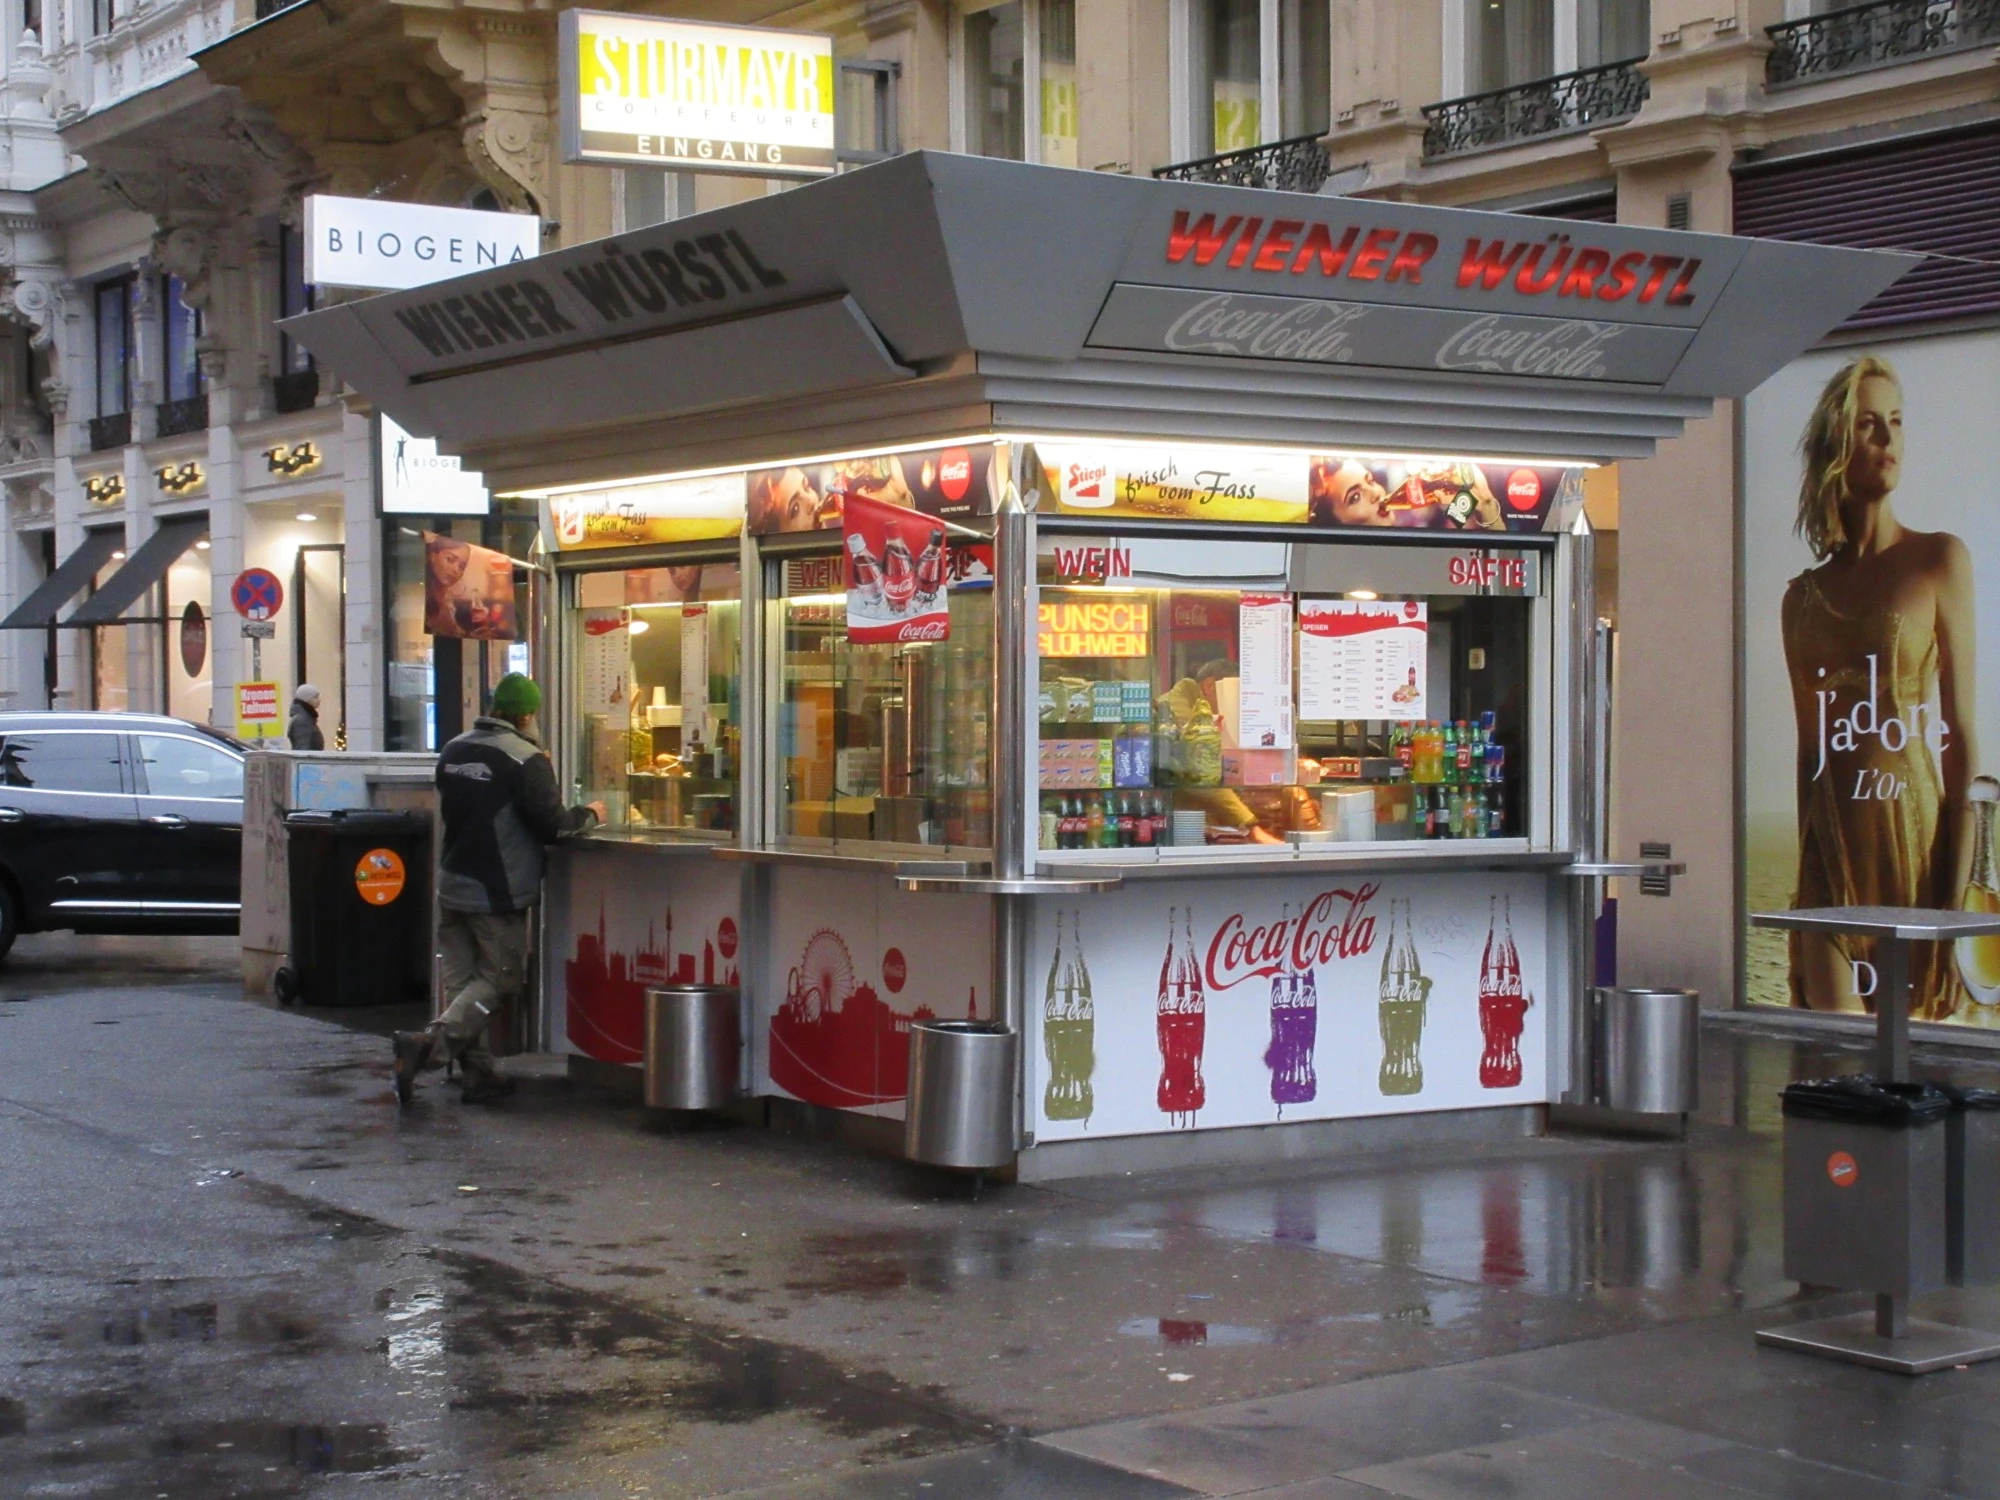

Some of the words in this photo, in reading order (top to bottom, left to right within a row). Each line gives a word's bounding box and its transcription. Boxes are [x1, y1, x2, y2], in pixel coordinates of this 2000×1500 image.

[594, 33, 821, 112] STURMAYR
[638, 135, 783, 163] EINGANG
[329, 228, 525, 265] BIOGENA
[1166, 210, 1439, 284] WIENER
[1456, 232, 1702, 307] WÜRSTL
[395, 280, 577, 358] WIENER
[563, 229, 789, 323] WÜRSTL
[413, 458, 458, 469] BIOGE
[1069, 463, 1107, 489] Stiegl
[1125, 456, 1178, 503] frisch
[1158, 485, 1193, 500] vom
[1194, 470, 1256, 504] Fass
[618, 503, 647, 533] Fass
[1055, 547, 1133, 578] WEIN
[1448, 551, 1527, 587] SÄFTE
[899, 622, 947, 640] Coca-Cola
[241, 689, 276, 701] Kronen
[1812, 653, 1950, 782] j'adore
[1205, 881, 1381, 992] Coca-Cola
